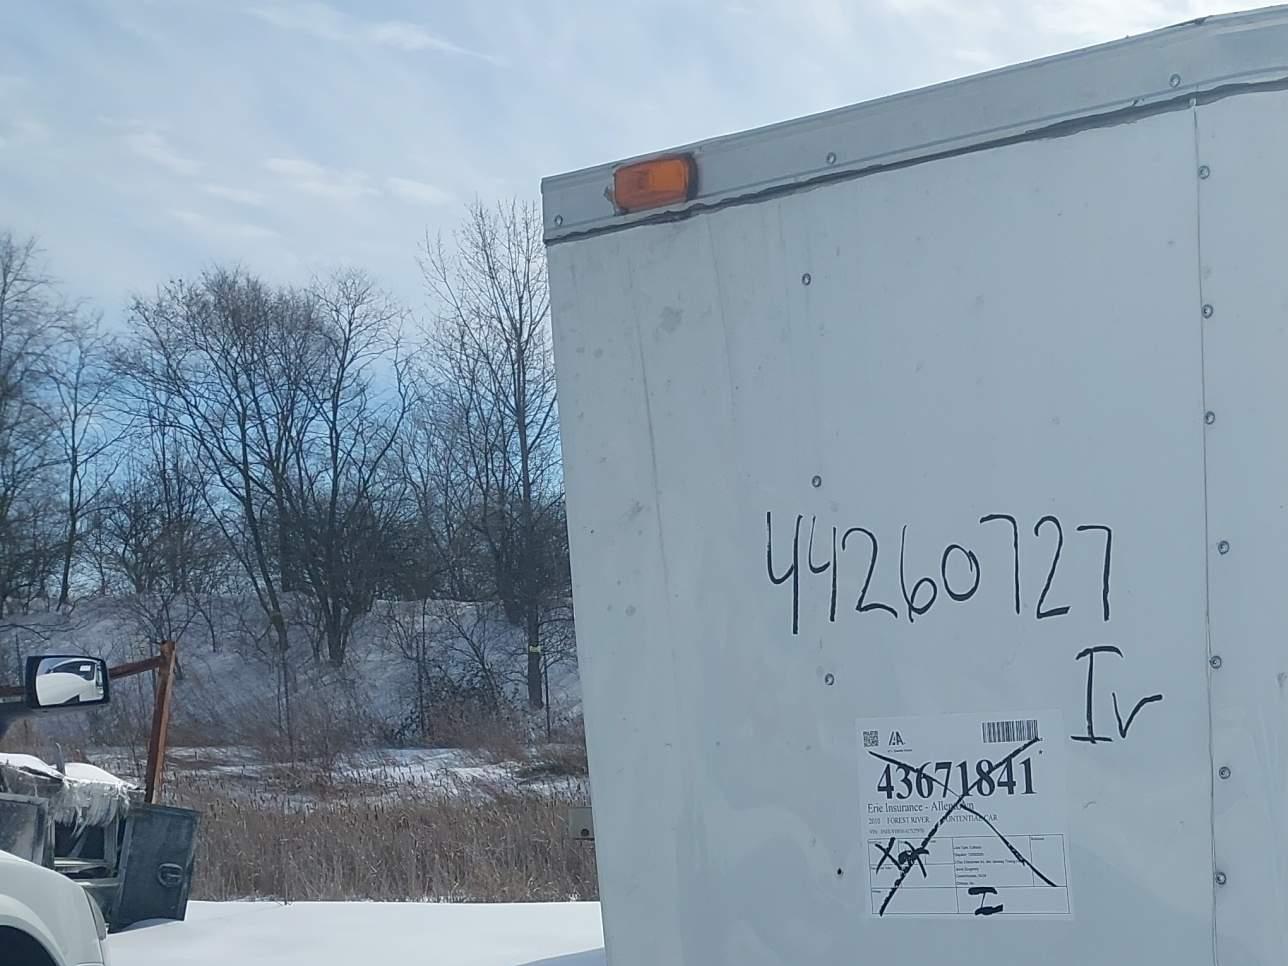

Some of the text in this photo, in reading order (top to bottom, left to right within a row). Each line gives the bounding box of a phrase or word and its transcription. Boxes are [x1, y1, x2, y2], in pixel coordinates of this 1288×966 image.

[766, 511, 1113, 635] 44260727
[877, 757, 1037, 800] 43671841
[885, 802, 923, 813] Insurance
